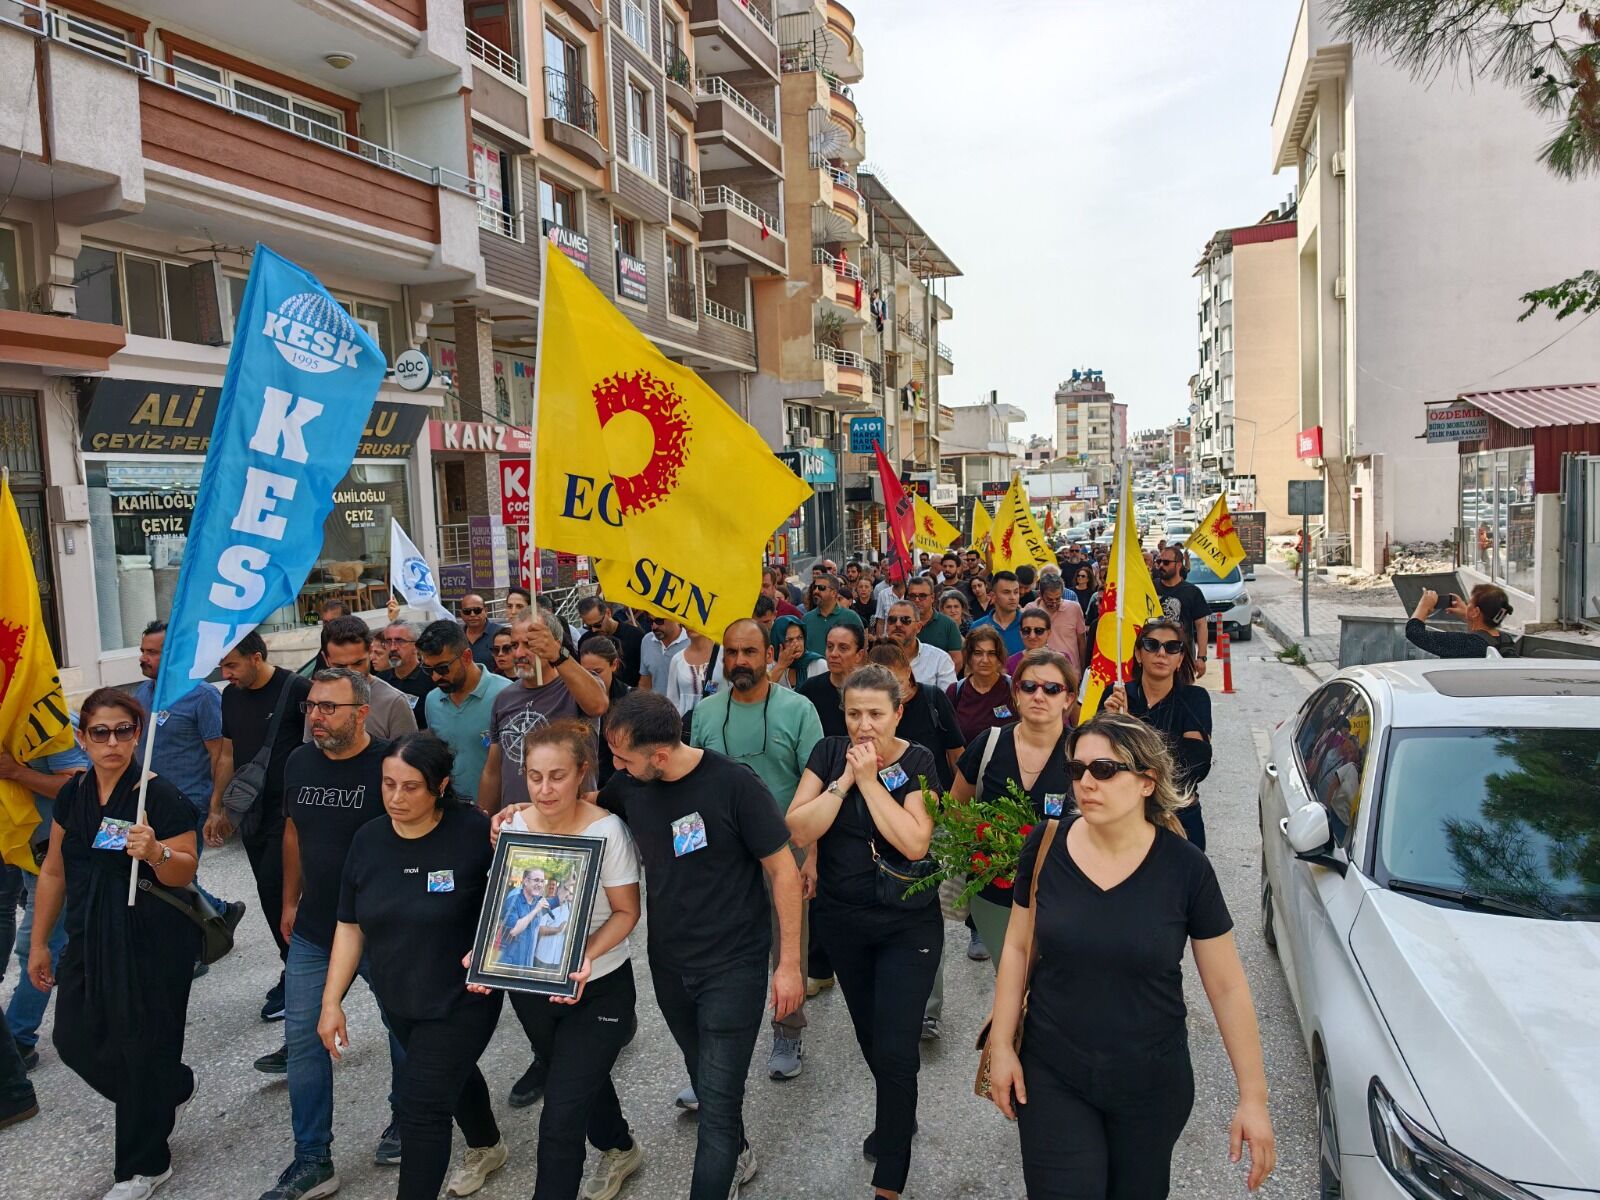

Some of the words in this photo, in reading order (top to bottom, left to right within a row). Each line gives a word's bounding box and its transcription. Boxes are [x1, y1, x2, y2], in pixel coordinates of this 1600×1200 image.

[558, 229, 589, 253] ALMES
[262, 312, 362, 368] KESK
[292, 352, 319, 370] 1995
[397, 360, 424, 374] abc
[130, 388, 206, 428] ALİ
[444, 421, 507, 451] KANZ
[853, 422, 881, 432] A-101
[141, 514, 184, 537] ÇEYİZ
[345, 506, 374, 525] ÇEYİZ
[1208, 546, 1229, 567] SEN
[441, 575, 467, 589] ÇEYİZ
[626, 557, 719, 627] SEN
[297, 784, 366, 809] mavi
[403, 866, 419, 874] mavi
